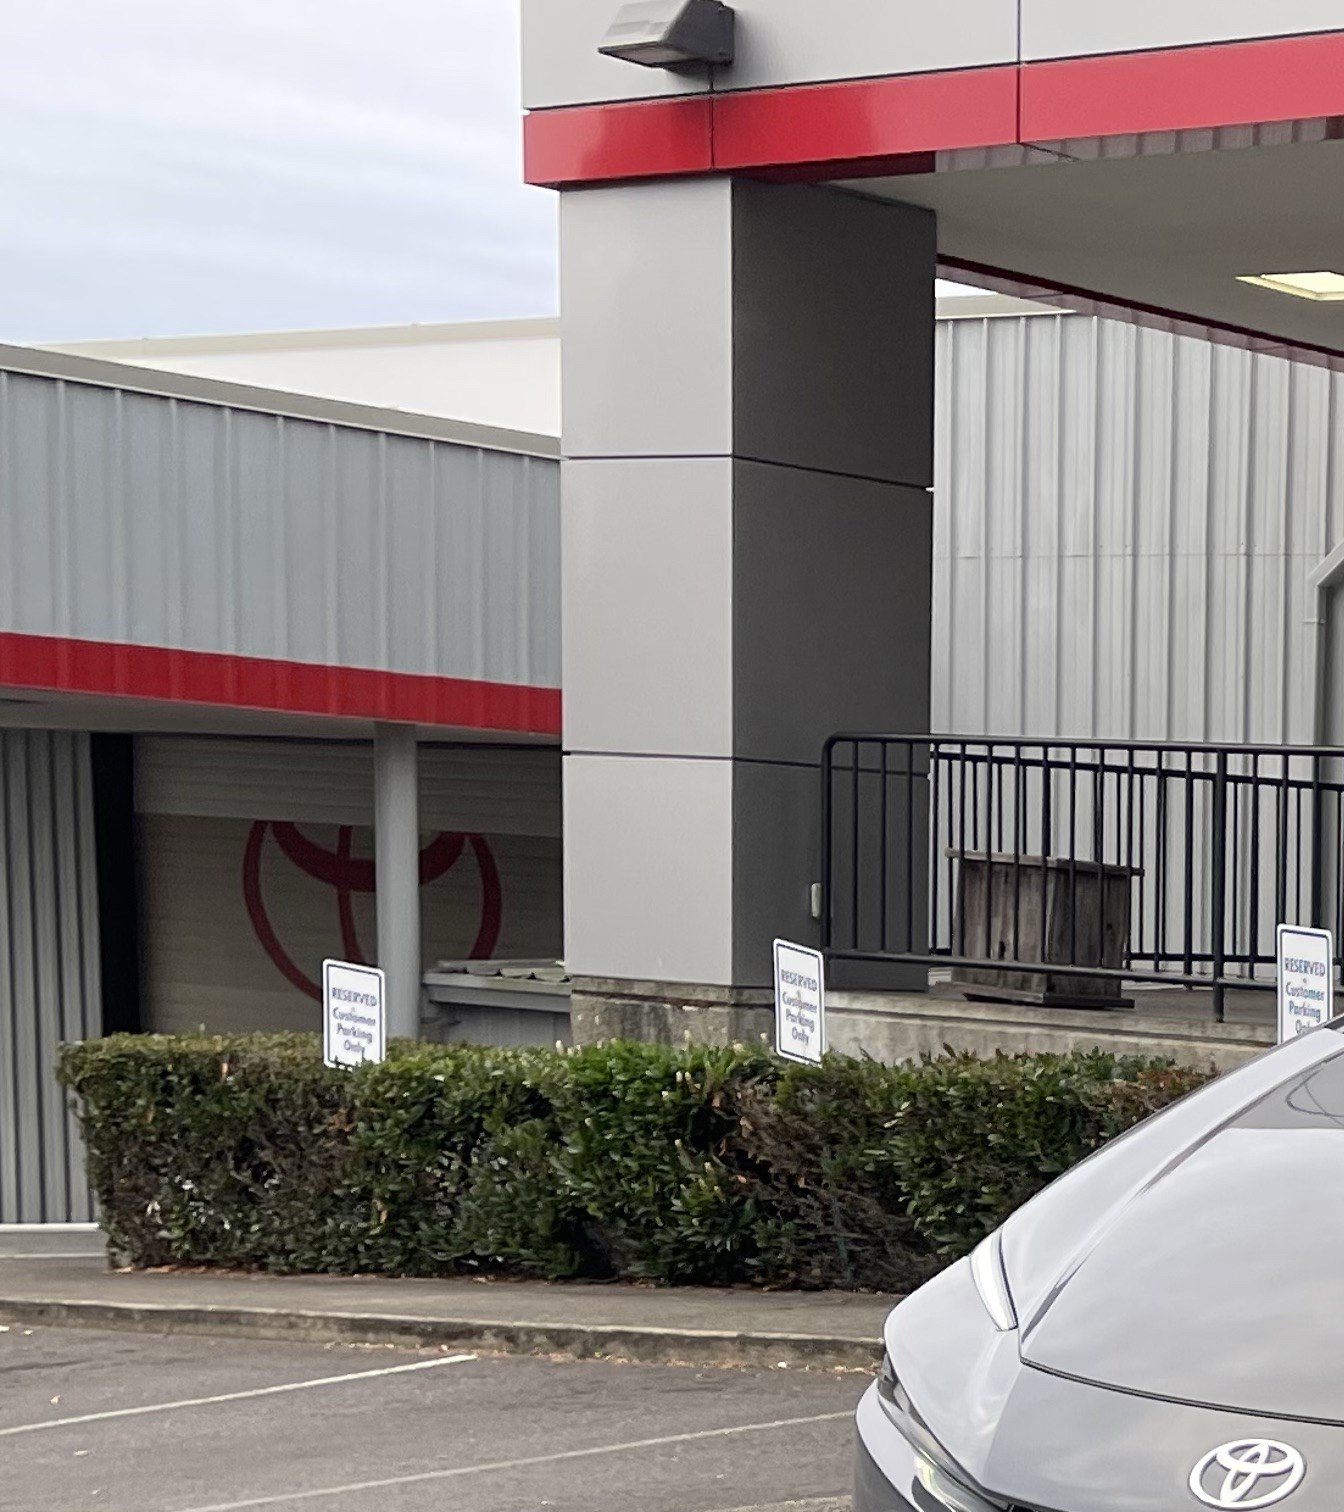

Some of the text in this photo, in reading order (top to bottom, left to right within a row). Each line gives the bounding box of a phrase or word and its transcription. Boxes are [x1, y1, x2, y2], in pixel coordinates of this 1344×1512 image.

[1284, 957, 1326, 977] RESERVED
[332, 987, 378, 1007] RESERVED
[1285, 982, 1325, 1001] Customer
[1288, 1000, 1321, 1023] Parking
